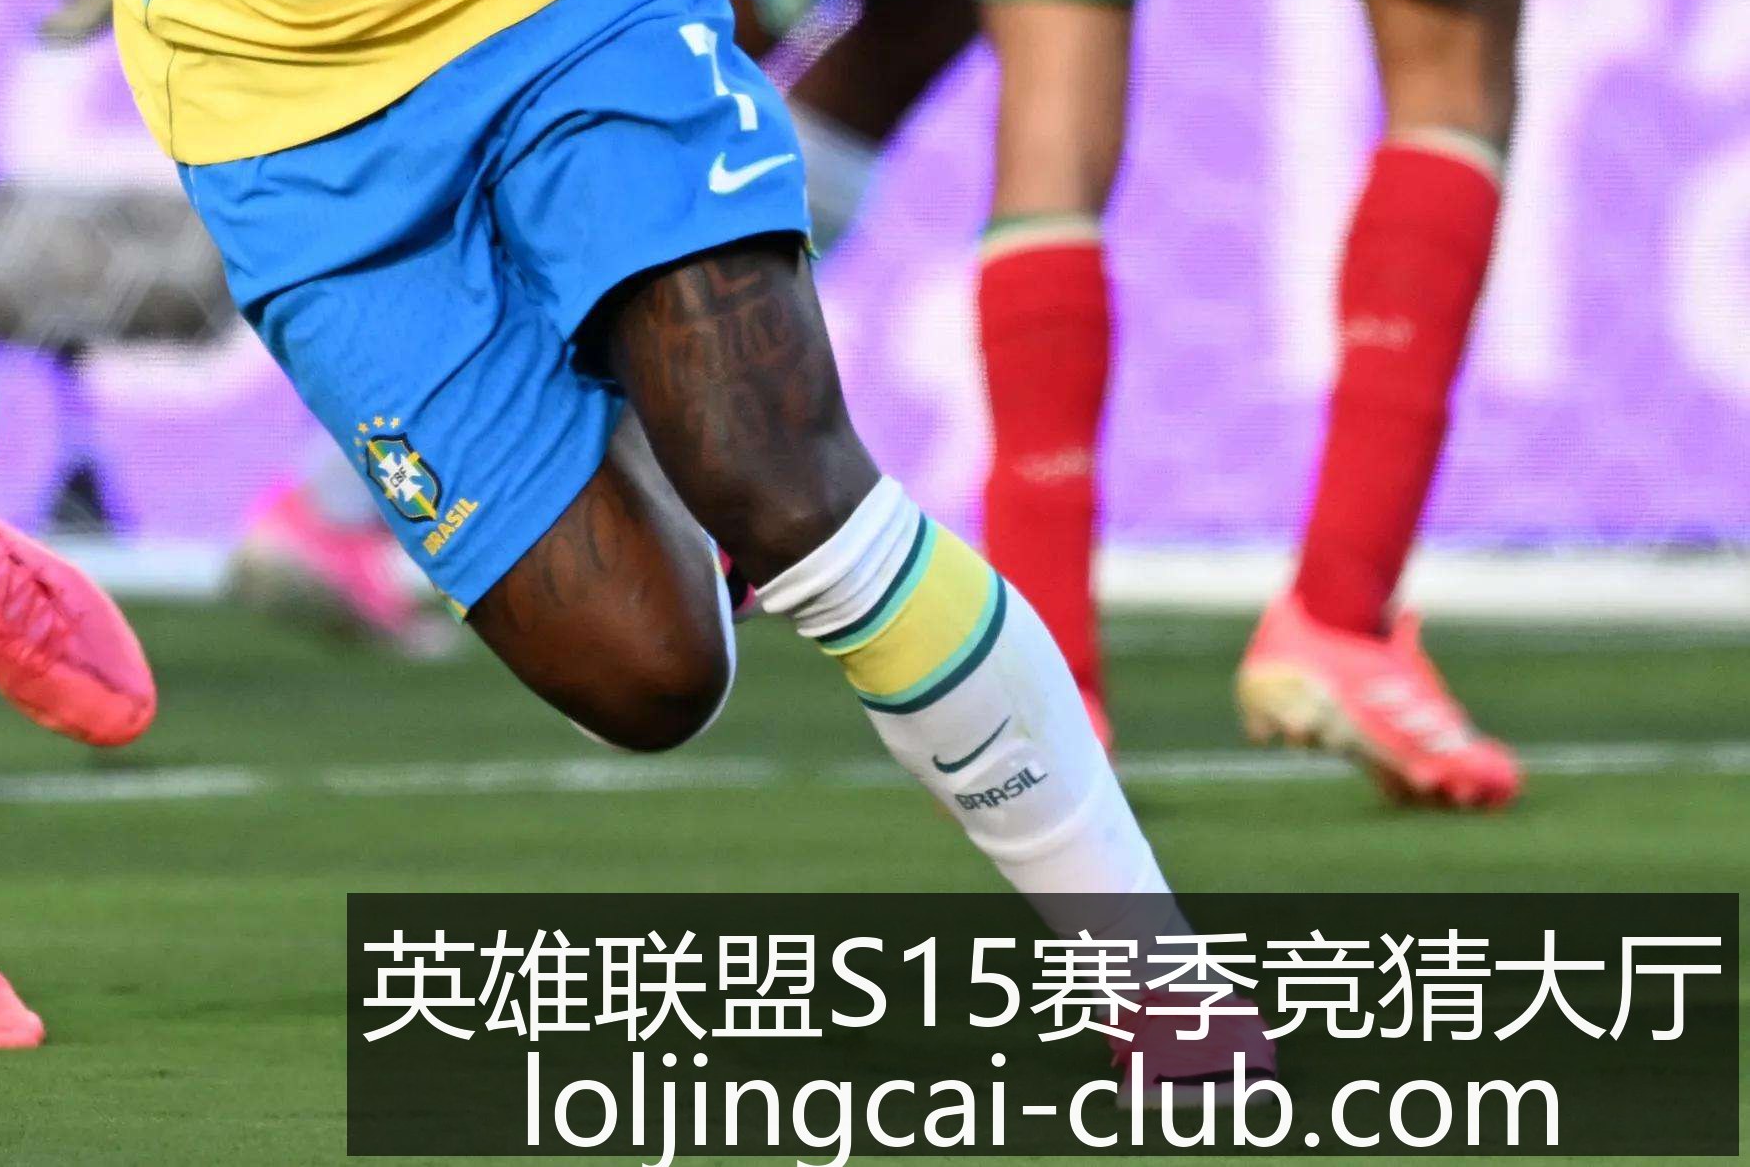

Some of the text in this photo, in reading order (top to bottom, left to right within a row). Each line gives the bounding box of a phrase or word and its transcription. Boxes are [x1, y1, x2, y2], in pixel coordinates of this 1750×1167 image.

[678, 22, 759, 132] 7
[389, 466, 408, 488] CBF
[424, 498, 479, 556] BRASIL
[954, 766, 1048, 811] BRASIL
